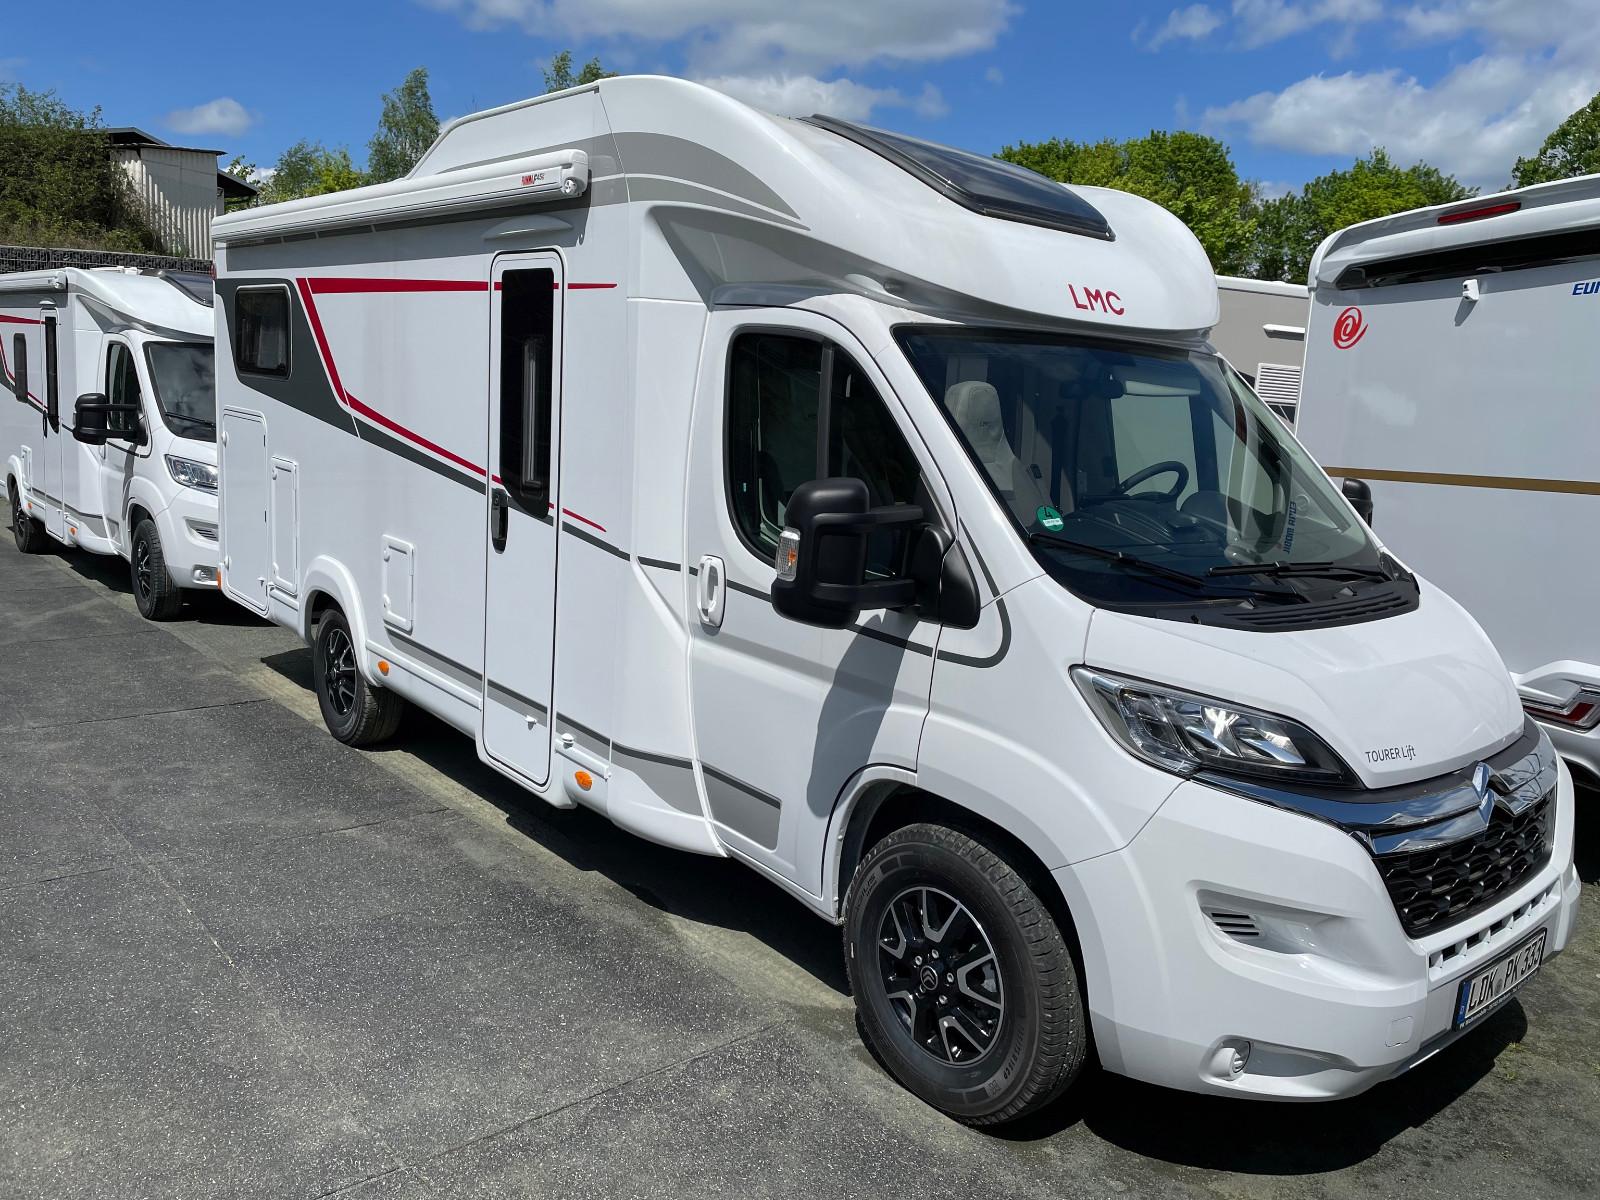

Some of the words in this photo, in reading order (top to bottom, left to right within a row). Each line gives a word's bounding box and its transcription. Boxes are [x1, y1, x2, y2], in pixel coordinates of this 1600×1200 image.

[1068, 284, 1124, 315] LMC
[1365, 748, 1401, 763] TOURER
[1401, 745, 1416, 760] Lift
[1468, 967, 1498, 1012] LDK
[1504, 951, 1522, 988] PK
[1521, 936, 1544, 975] 333
